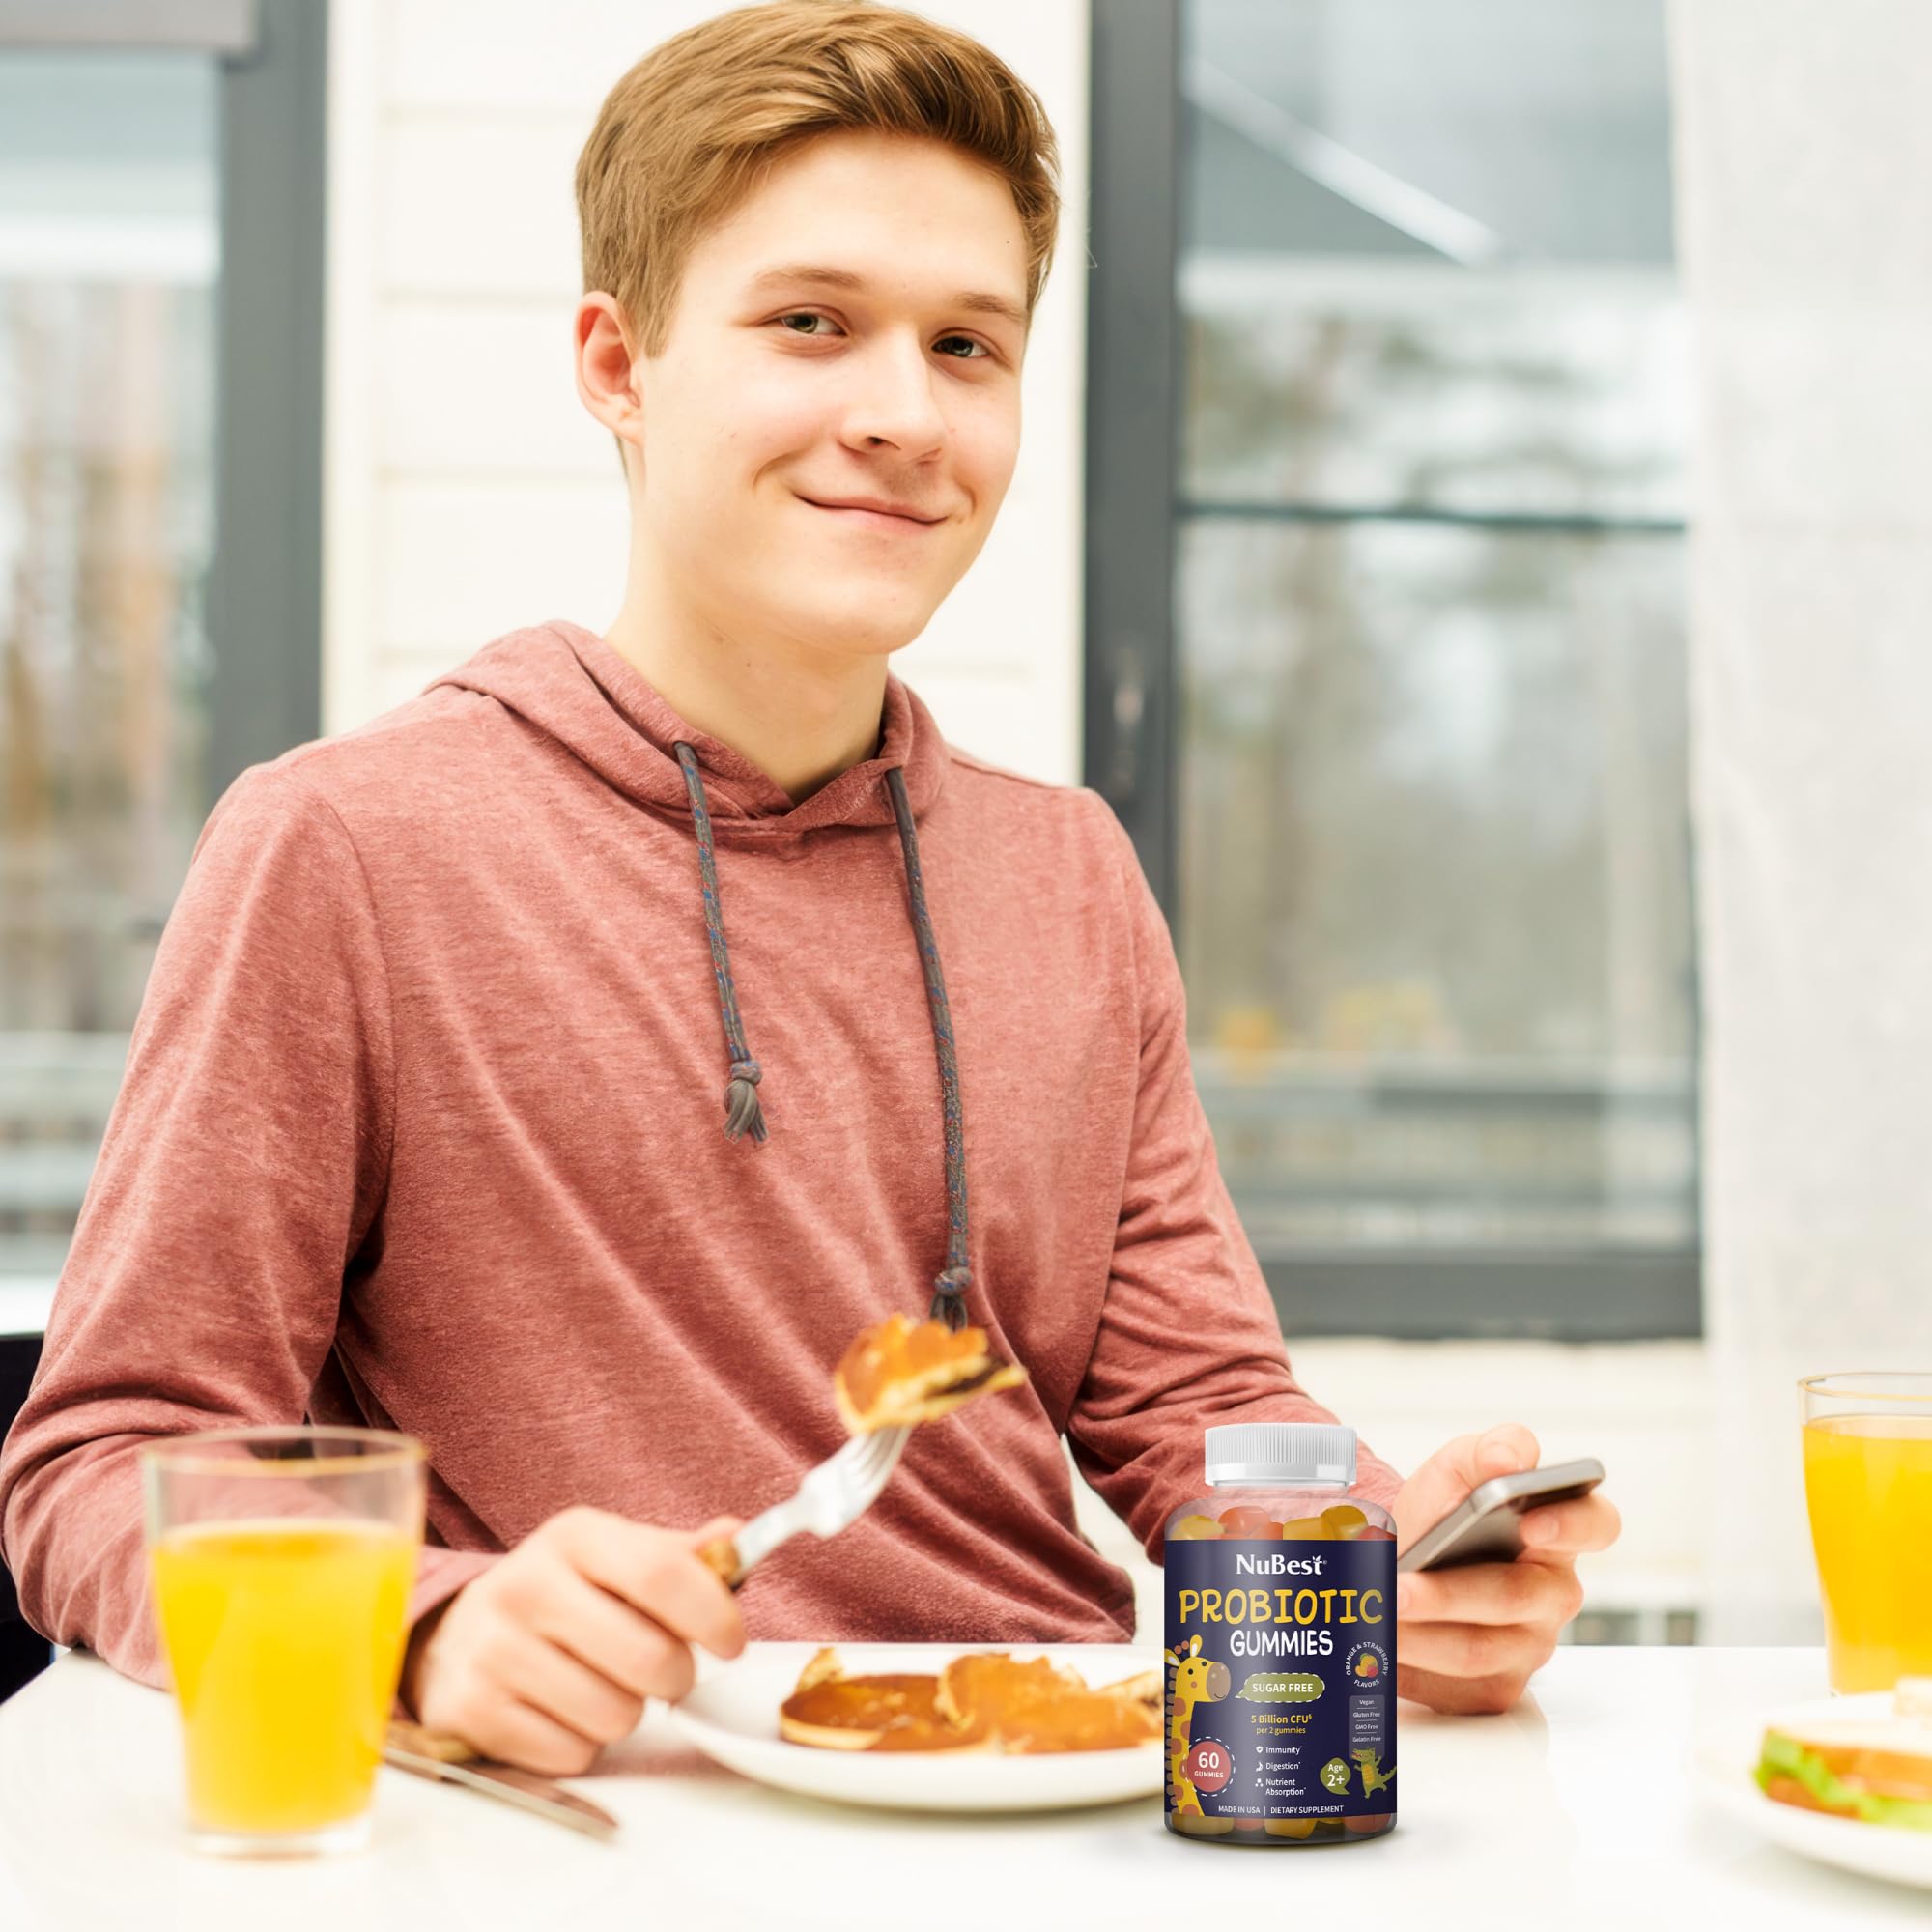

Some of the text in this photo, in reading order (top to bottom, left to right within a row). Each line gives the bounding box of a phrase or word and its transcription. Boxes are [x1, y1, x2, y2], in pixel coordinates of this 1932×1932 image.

[1179, 1588, 1383, 1625] PROBIOTIC
[1230, 1630, 1333, 1657] GUMMIES
[1345, 1647, 1357, 1676] ORANGE
[1363, 1641, 1389, 1676] STRAWBERRY
[1252, 1683, 1314, 1692] SUGAR FREE
[1353, 1679, 1379, 1688] FLAVORS
[1251, 1715, 1257, 1723] 5
[1259, 1714, 1288, 1723] Billion
[1256, 1727, 1267, 1736] per
[1274, 1726, 1306, 1736] gummies
[1198, 1751, 1219, 1769] 60
[1194, 1770, 1224, 1778] GUMMIES
[1327, 1764, 1344, 1774] Age
[1327, 1774, 1345, 1787] 2+
[1298, 1804, 1344, 1814] SUPPLEMENT
